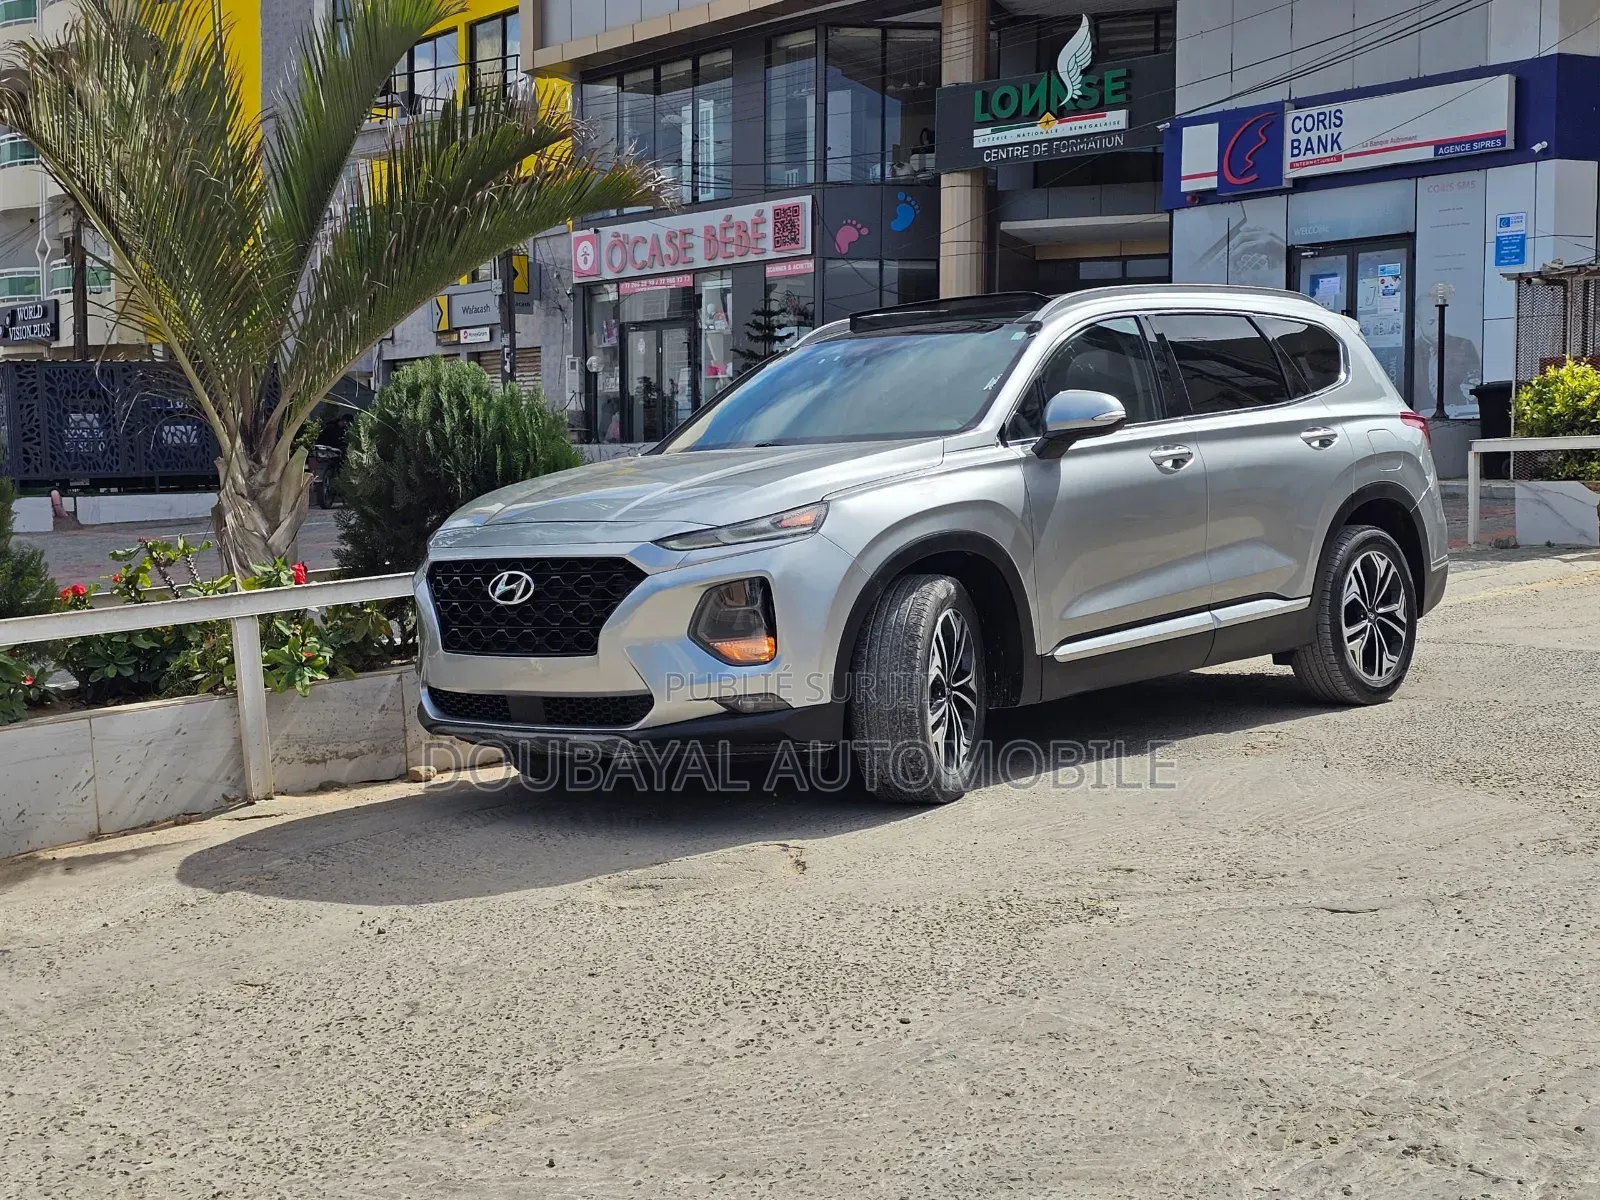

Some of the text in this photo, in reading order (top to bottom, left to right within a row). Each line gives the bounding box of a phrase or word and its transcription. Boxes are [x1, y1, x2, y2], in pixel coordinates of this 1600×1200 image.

[1291, 108, 1344, 134] CORIS
[977, 135, 1008, 144] LOTERIE
[1016, 128, 1059, 138] NATIONALE
[1290, 131, 1343, 158] BANK
[1369, 139, 1389, 148] Banque
[983, 134, 1125, 163] CENTRE DE FORMATION
[1437, 138, 1502, 156] AGENCE SIPRES
[703, 208, 767, 261] BÉBÉ
[17, 304, 43, 321] WORLD
[461, 303, 491, 315] Wafacash
[9, 322, 51, 342] VISION PLUS
